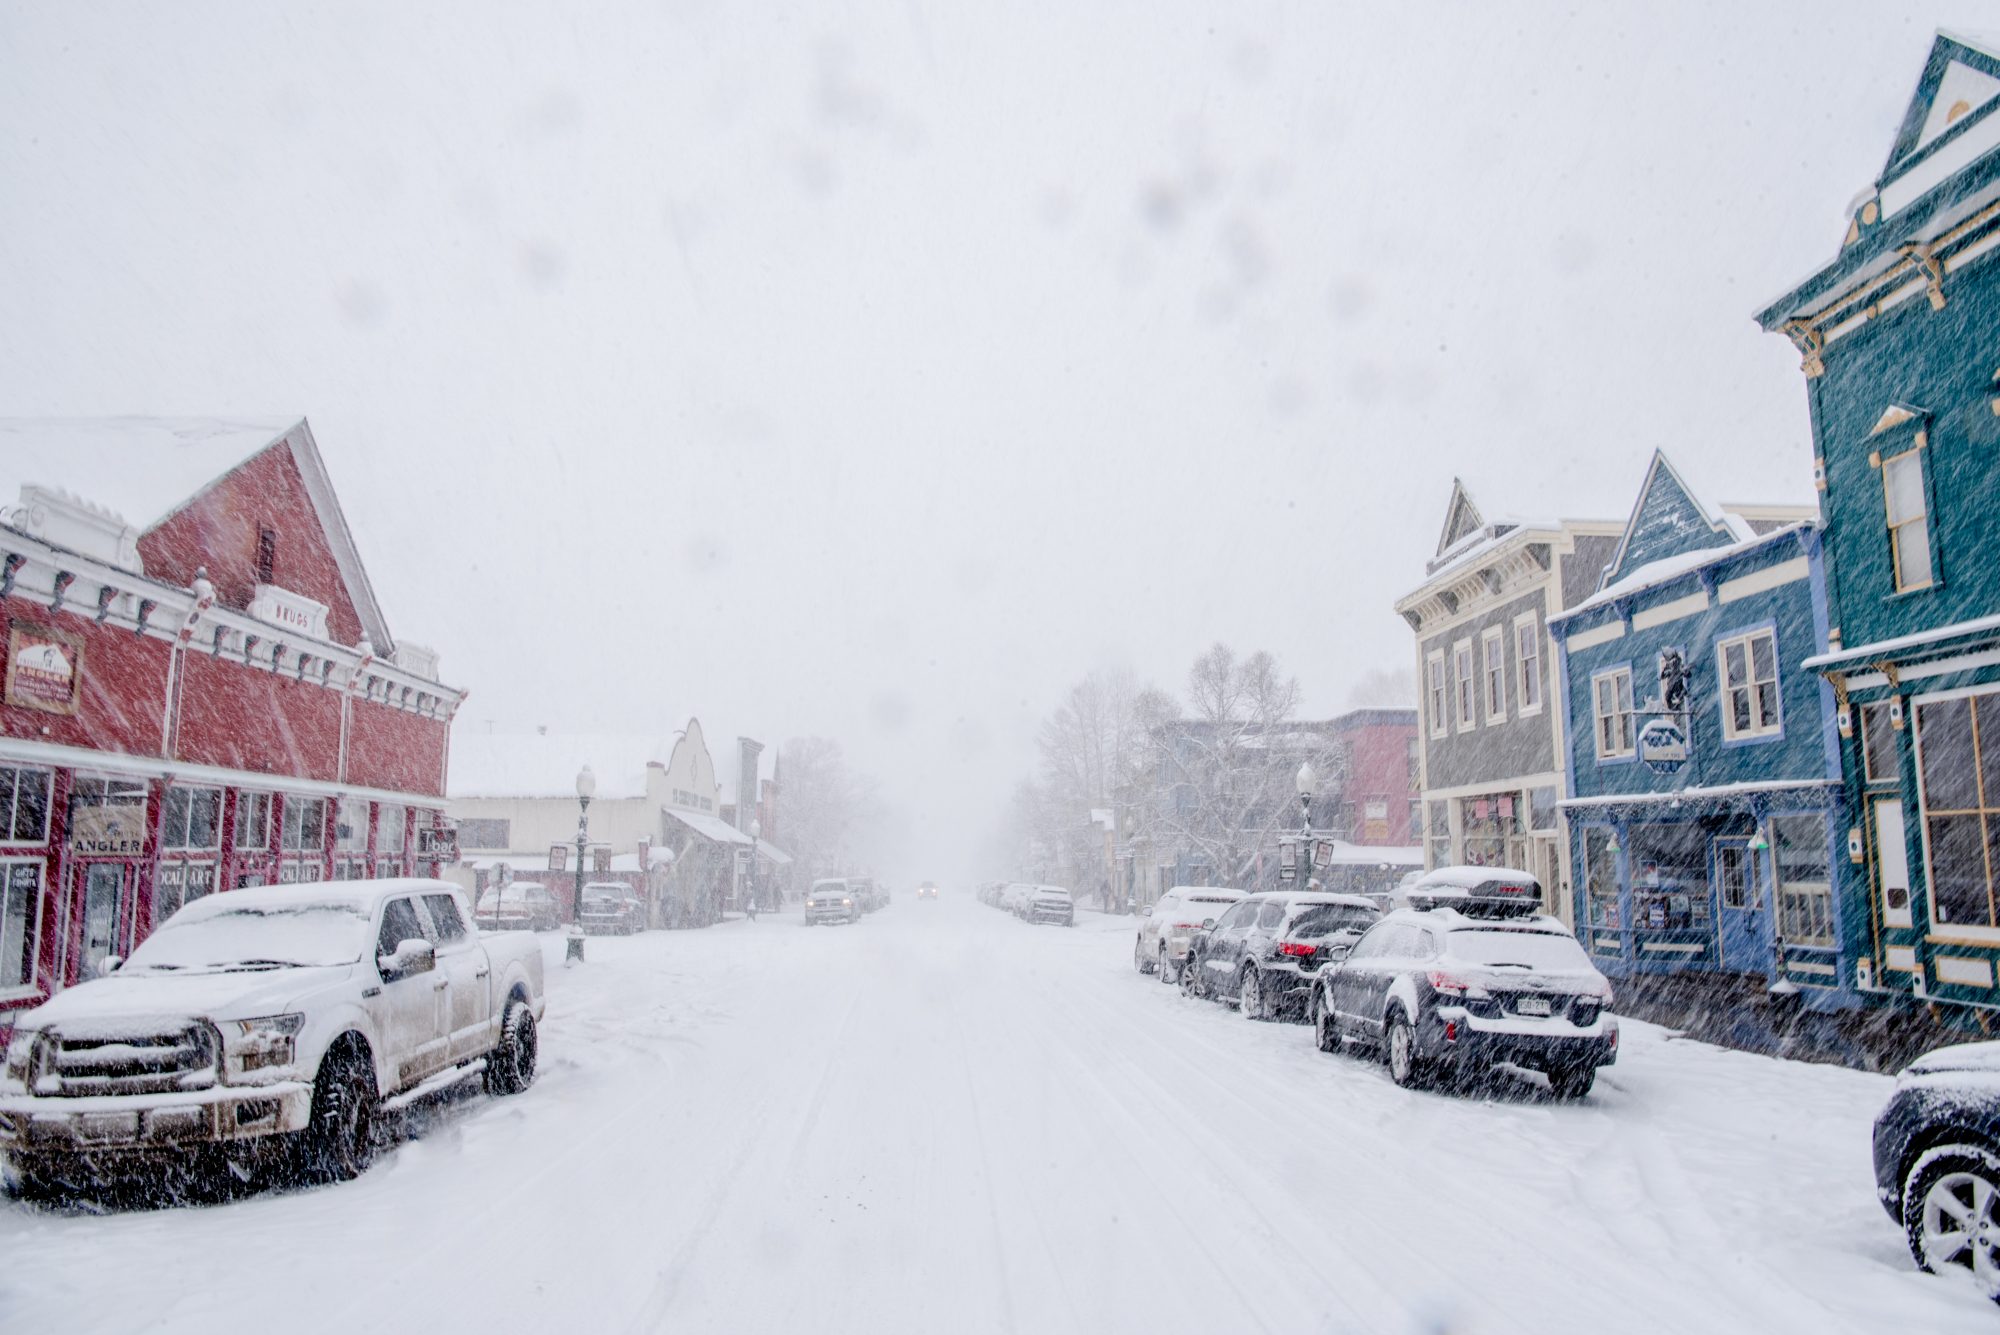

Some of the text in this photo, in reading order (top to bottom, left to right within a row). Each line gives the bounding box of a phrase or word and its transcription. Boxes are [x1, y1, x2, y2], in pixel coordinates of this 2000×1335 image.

[276, 604, 308, 628] DRUGS
[75, 840, 140, 853] ANGLER
[190, 870, 212, 886] ART
